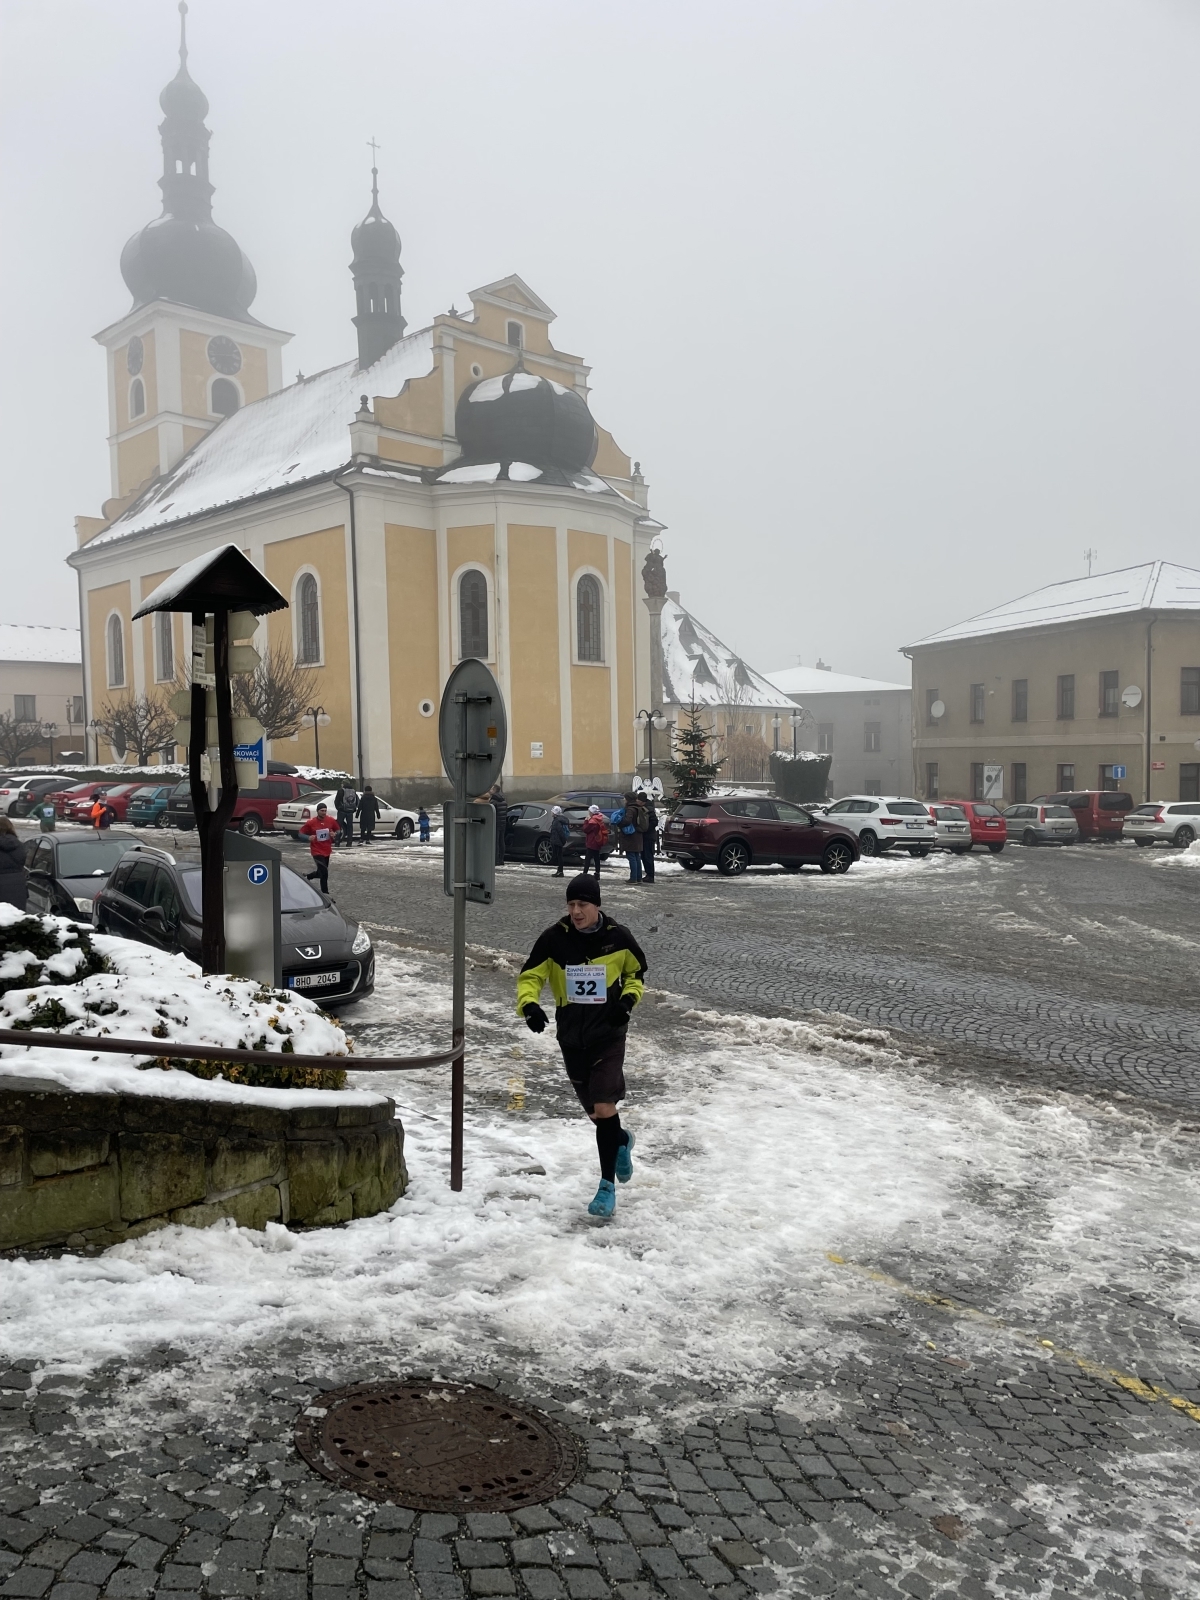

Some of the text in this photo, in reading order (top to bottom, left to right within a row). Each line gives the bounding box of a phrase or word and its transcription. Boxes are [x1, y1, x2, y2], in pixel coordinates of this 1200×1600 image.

[254, 868, 264, 881] P
[317, 973, 337, 984] 2045
[575, 981, 597, 996] 32
